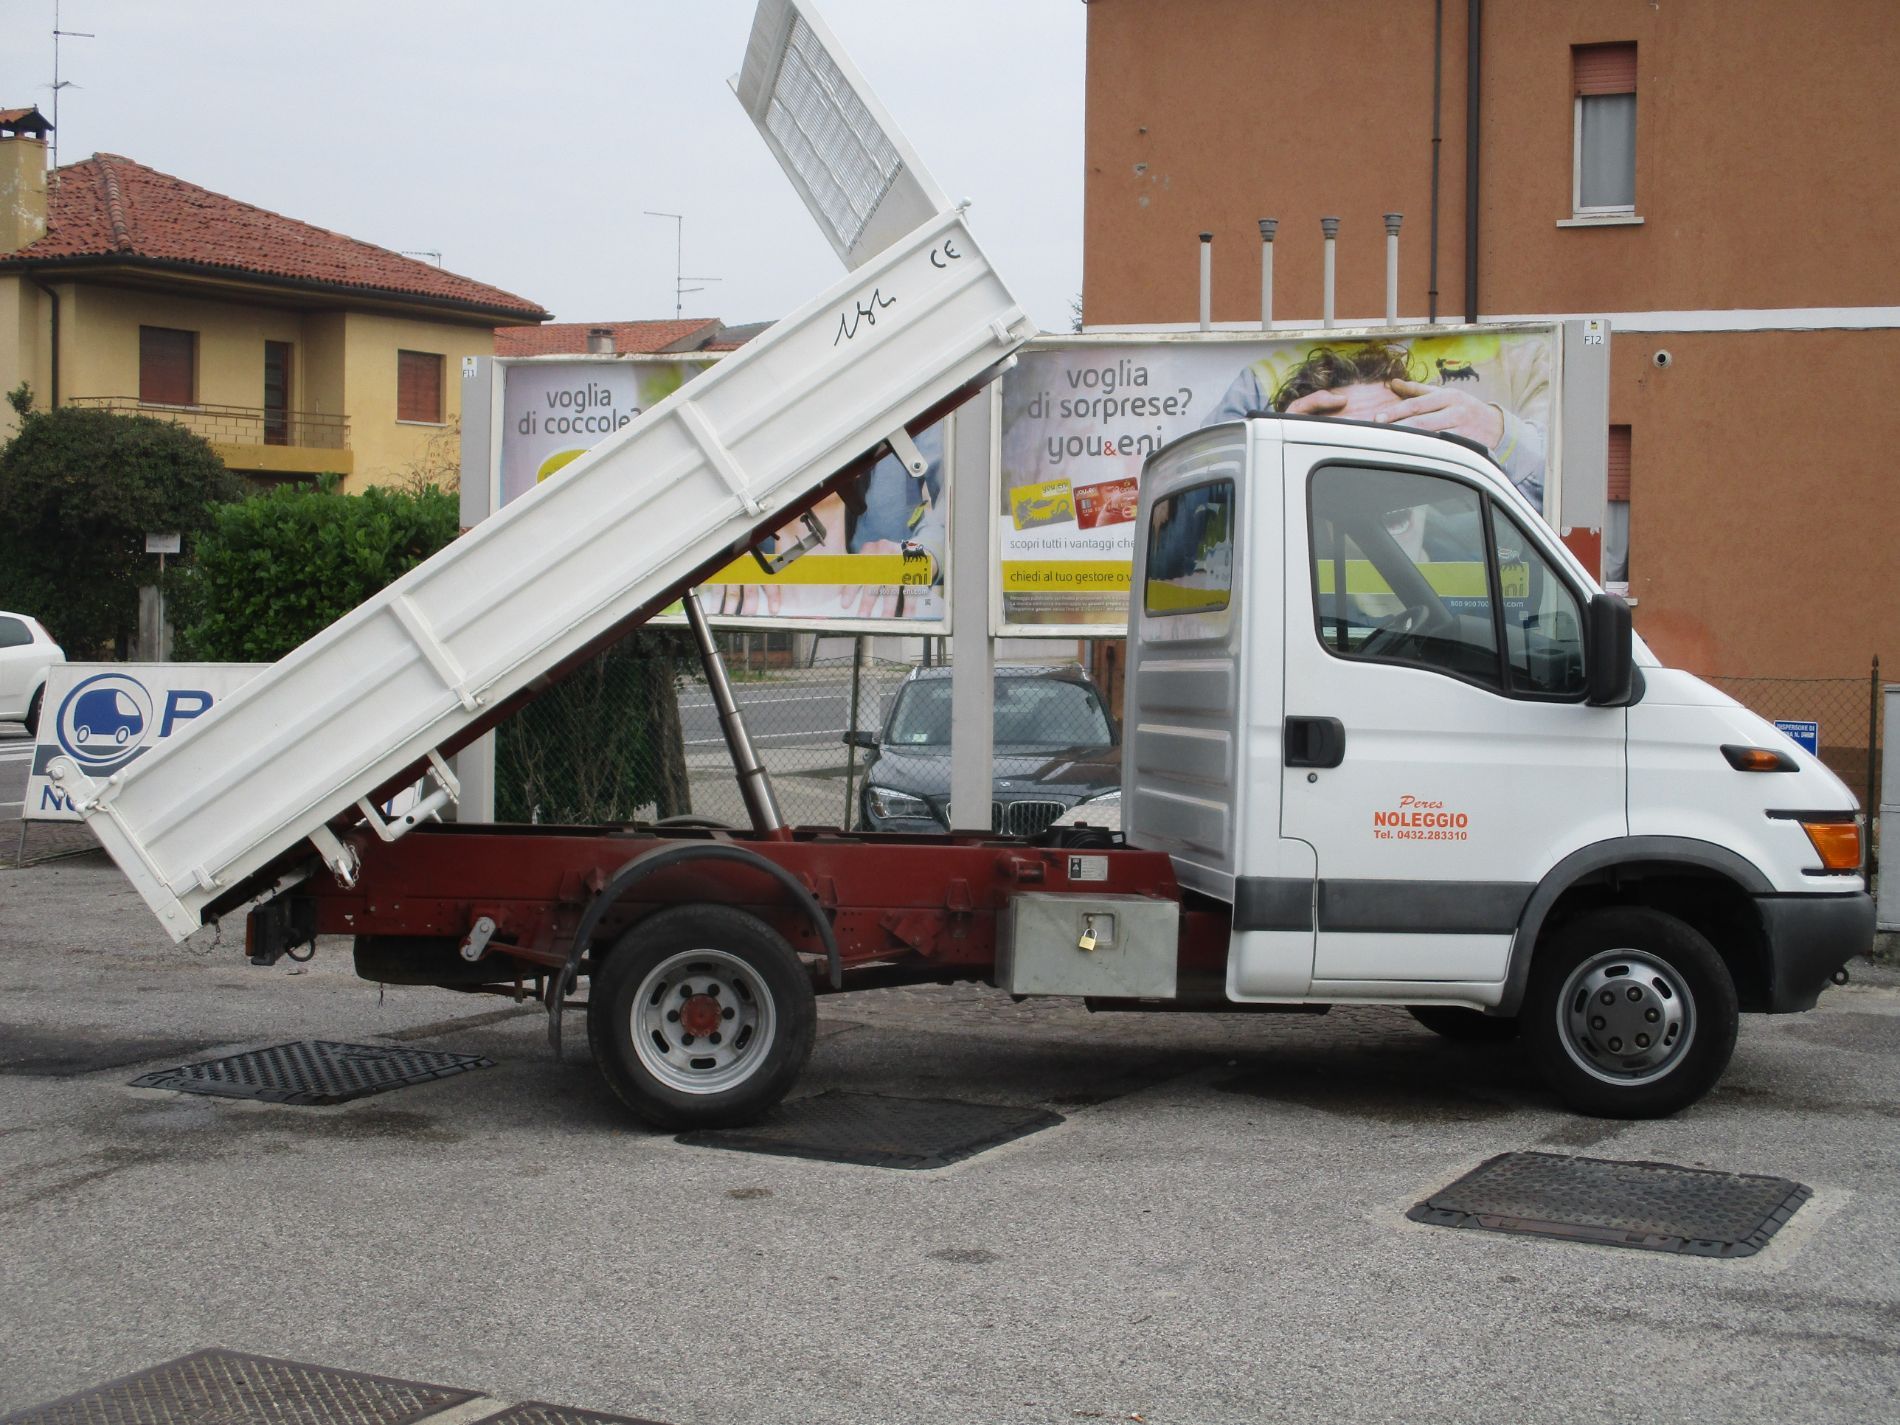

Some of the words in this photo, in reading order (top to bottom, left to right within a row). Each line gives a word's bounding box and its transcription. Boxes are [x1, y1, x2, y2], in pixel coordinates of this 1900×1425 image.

[930, 239, 961, 268] CE
[1066, 359, 1148, 395] voglia
[546, 383, 611, 413] voglia
[1027, 391, 1050, 419] di
[1060, 388, 1193, 424] sorprese?
[518, 411, 536, 435] di
[1048, 426, 1162, 464] you&eni
[1010, 538, 1039, 551] scopri
[1042, 538, 1061, 549] tutti
[1069, 538, 1115, 551] vantaggi
[901, 568, 928, 585] eni
[1010, 571, 1041, 582] chiedi
[1043, 571, 1053, 582] al
[1055, 572, 1073, 582] tuo
[1075, 572, 1114, 584] gestore
[1116, 574, 1124, 582] o
[1504, 577, 1524, 597] ni
[1399, 795, 1444, 809] Peres
[1374, 811, 1468, 828] NOLEGGIO
[1373, 829, 1394, 839] Tel.
[1397, 830, 1467, 841] 0432.283310
